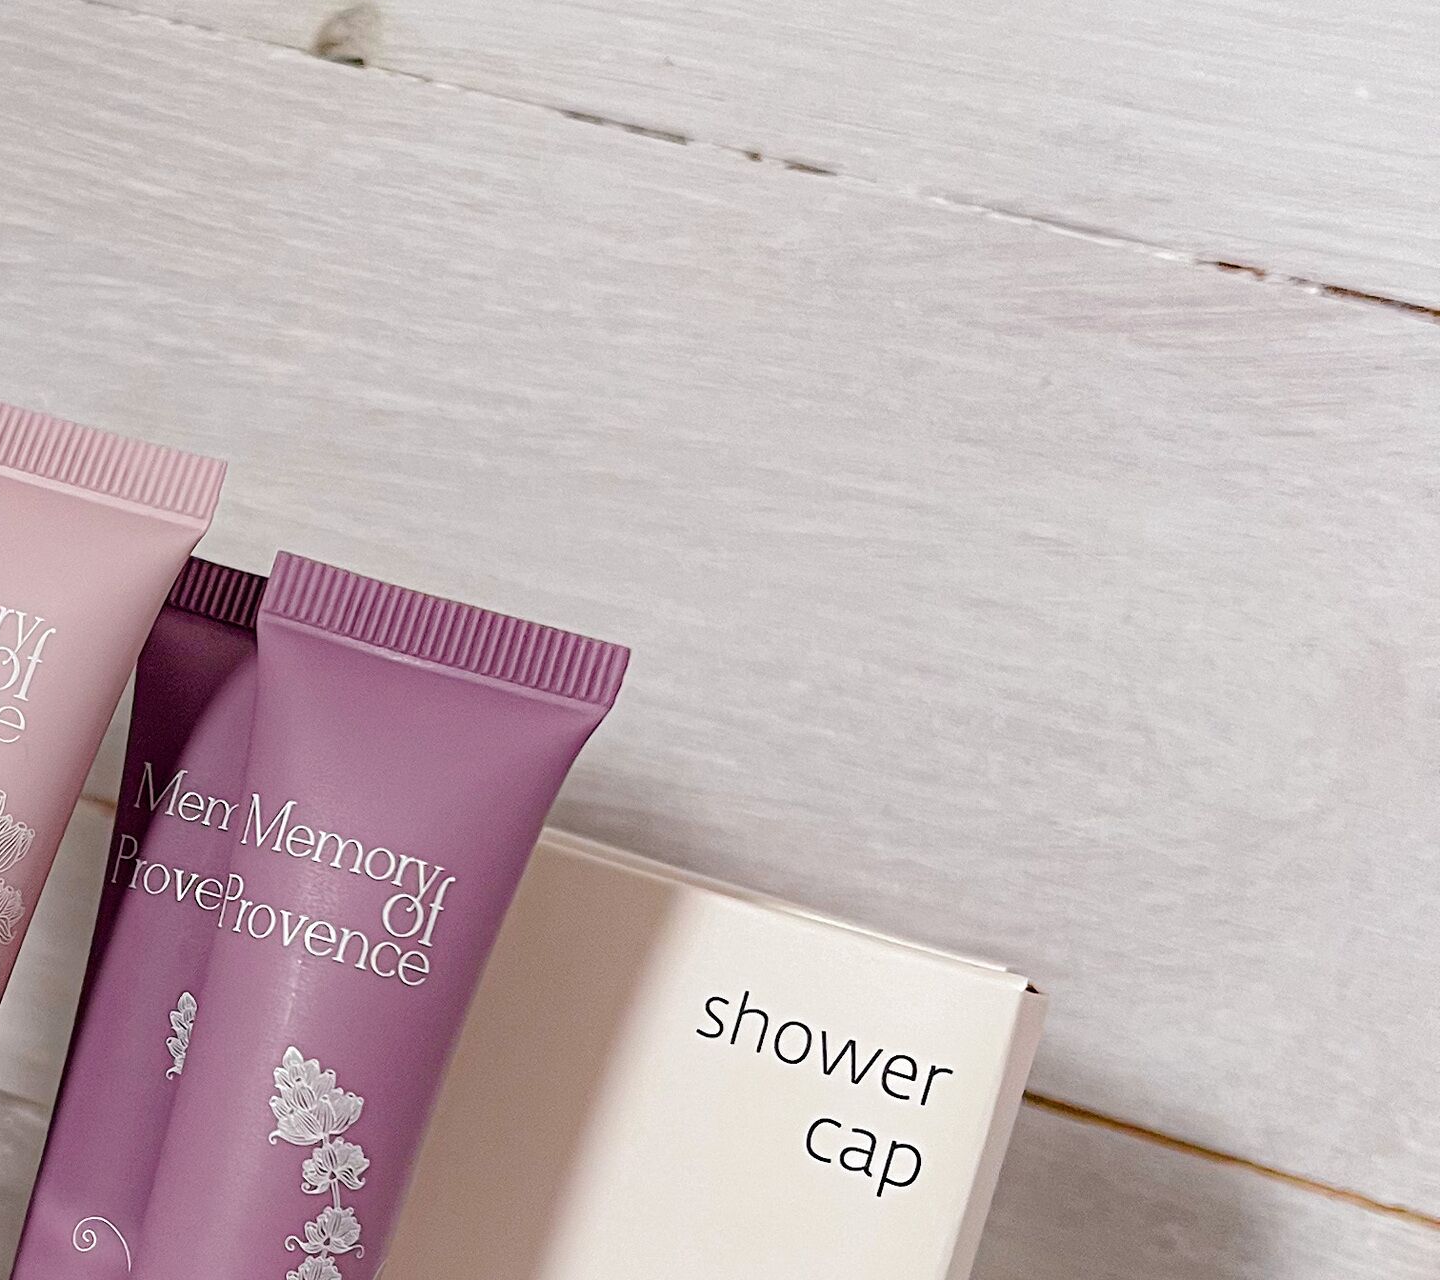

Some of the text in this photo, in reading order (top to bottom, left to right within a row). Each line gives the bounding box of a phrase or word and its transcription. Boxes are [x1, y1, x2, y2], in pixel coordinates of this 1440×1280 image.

[240, 793, 445, 912] Memory
[217, 873, 431, 987] Provence
[696, 990, 954, 1107] shower
[805, 1117, 922, 1198] cap
